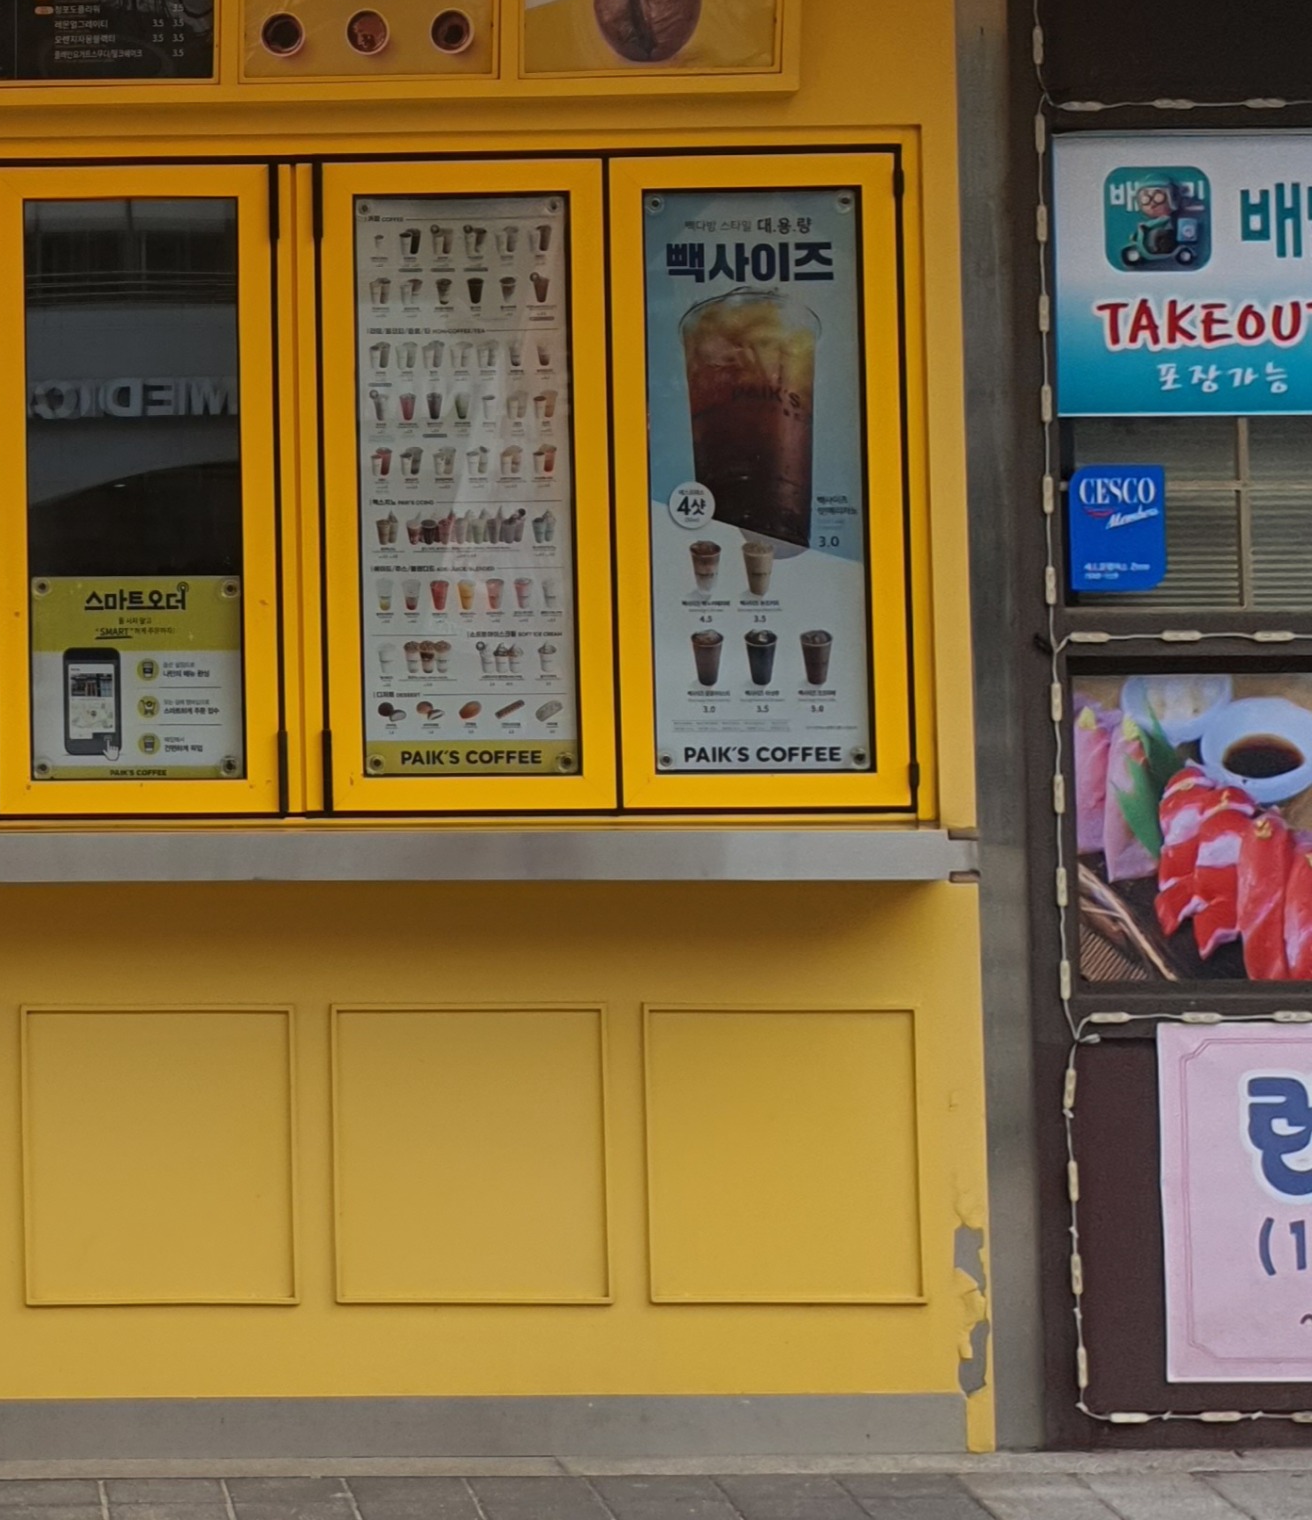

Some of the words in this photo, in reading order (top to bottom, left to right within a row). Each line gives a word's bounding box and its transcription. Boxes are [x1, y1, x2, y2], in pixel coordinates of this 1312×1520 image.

[1240, 182, 1312, 258] 배
[666, 241, 834, 283] 빽사이즈
[1157, 361, 1288, 394] 포장가능
[1079, 477, 1156, 505] CESCO
[818, 535, 840, 548] 3.0
[84, 589, 187, 610] 스마트오더
[401, 750, 460, 765] PAIK'S
[466, 750, 542, 765] COFFEE
[684, 746, 749, 763] PAIK'S
[756, 746, 842, 763] COFFEE
